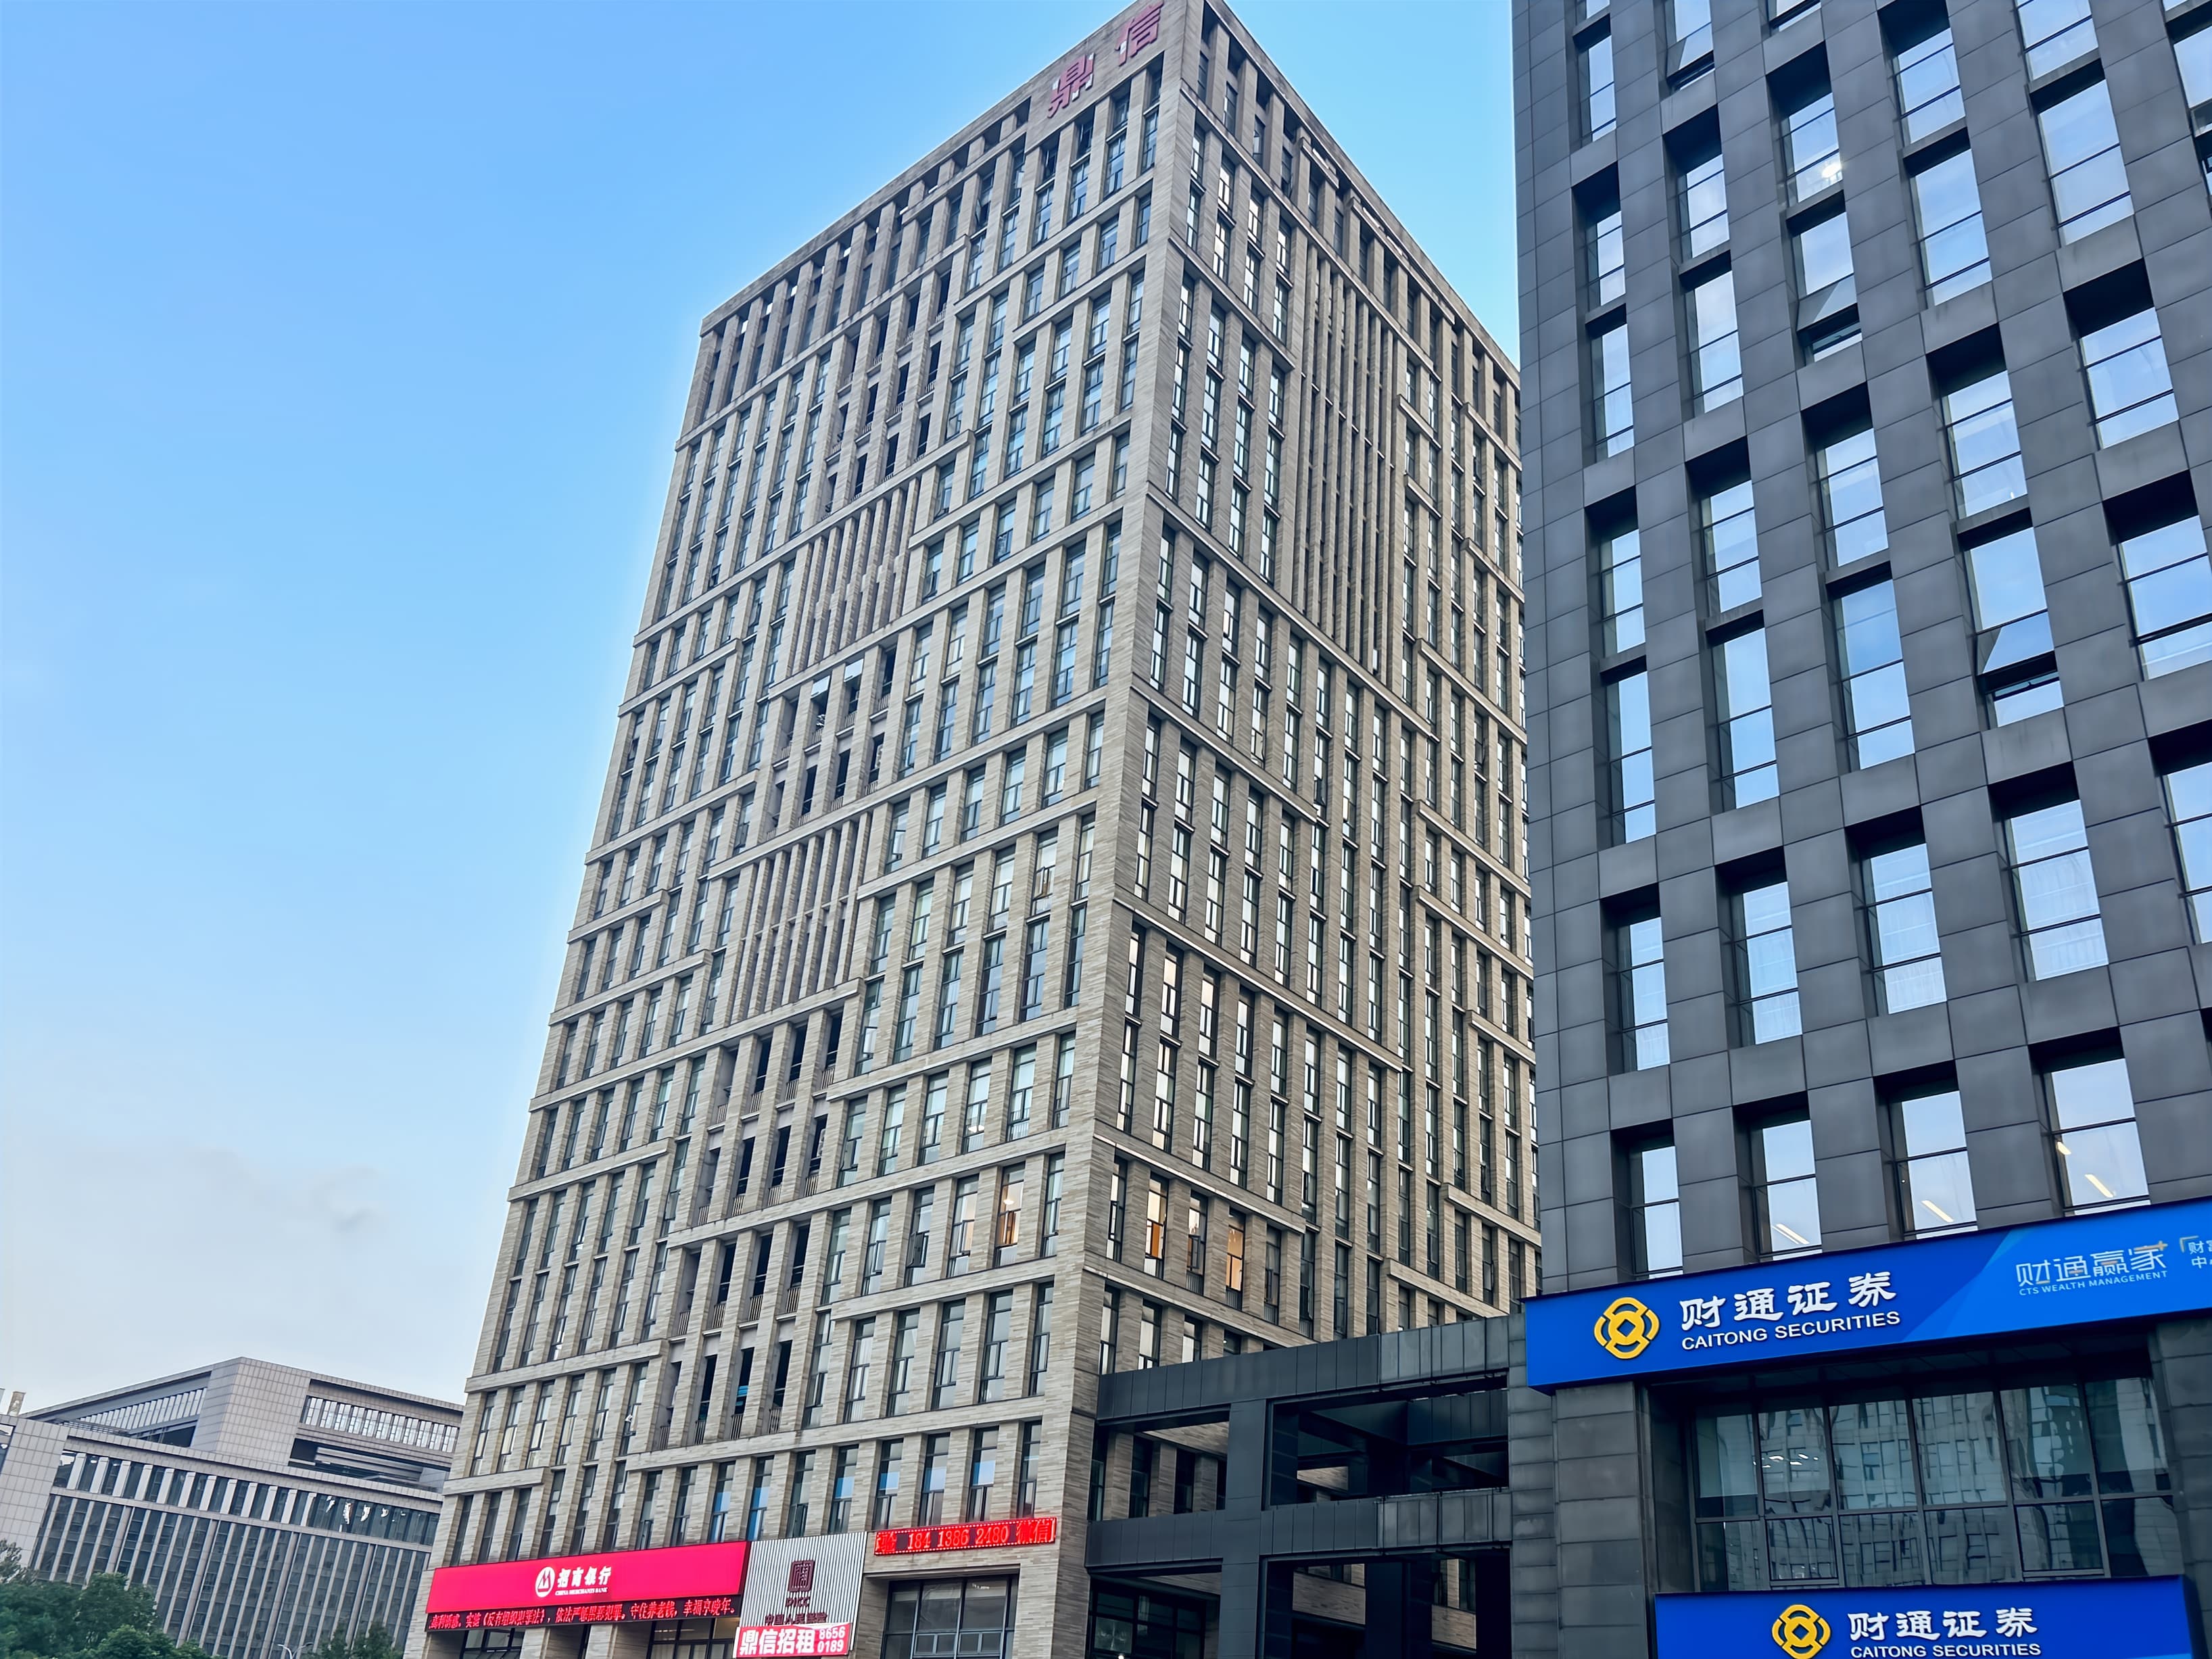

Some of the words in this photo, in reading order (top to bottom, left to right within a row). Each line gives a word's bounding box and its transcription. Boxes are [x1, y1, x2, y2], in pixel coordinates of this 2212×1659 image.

[1047, 1, 1163, 118] 鼎信
[2016, 1241, 2168, 1287] 财通赢家
[2191, 1256, 2212, 1269] 中
[2019, 1287, 2040, 1296] CTS
[2042, 1280, 2086, 1294] WEALTH
[2088, 1270, 2168, 1287] MANAGEMENT
[1679, 1271, 1898, 1332] 财通证券
[1681, 1328, 1768, 1351] CAITONG
[1775, 1311, 1901, 1339] SECURITIES
[908, 1532, 931, 1549] 184
[938, 1529, 969, 1547] 1386
[976, 1526, 1009, 1544] 2480
[557, 1566, 612, 1588] 招商银行
[765, 1612, 827, 1625] 中国人民保险
[1848, 1607, 2038, 1641] 财通证券
[740, 1628, 815, 1656] 鼎信招租
[819, 1627, 846, 1639] 8656
[817, 1639, 844, 1653] 0189
[1851, 1645, 1927, 1658] CAITONG
[1933, 1643, 2042, 1657] SECURITIES
